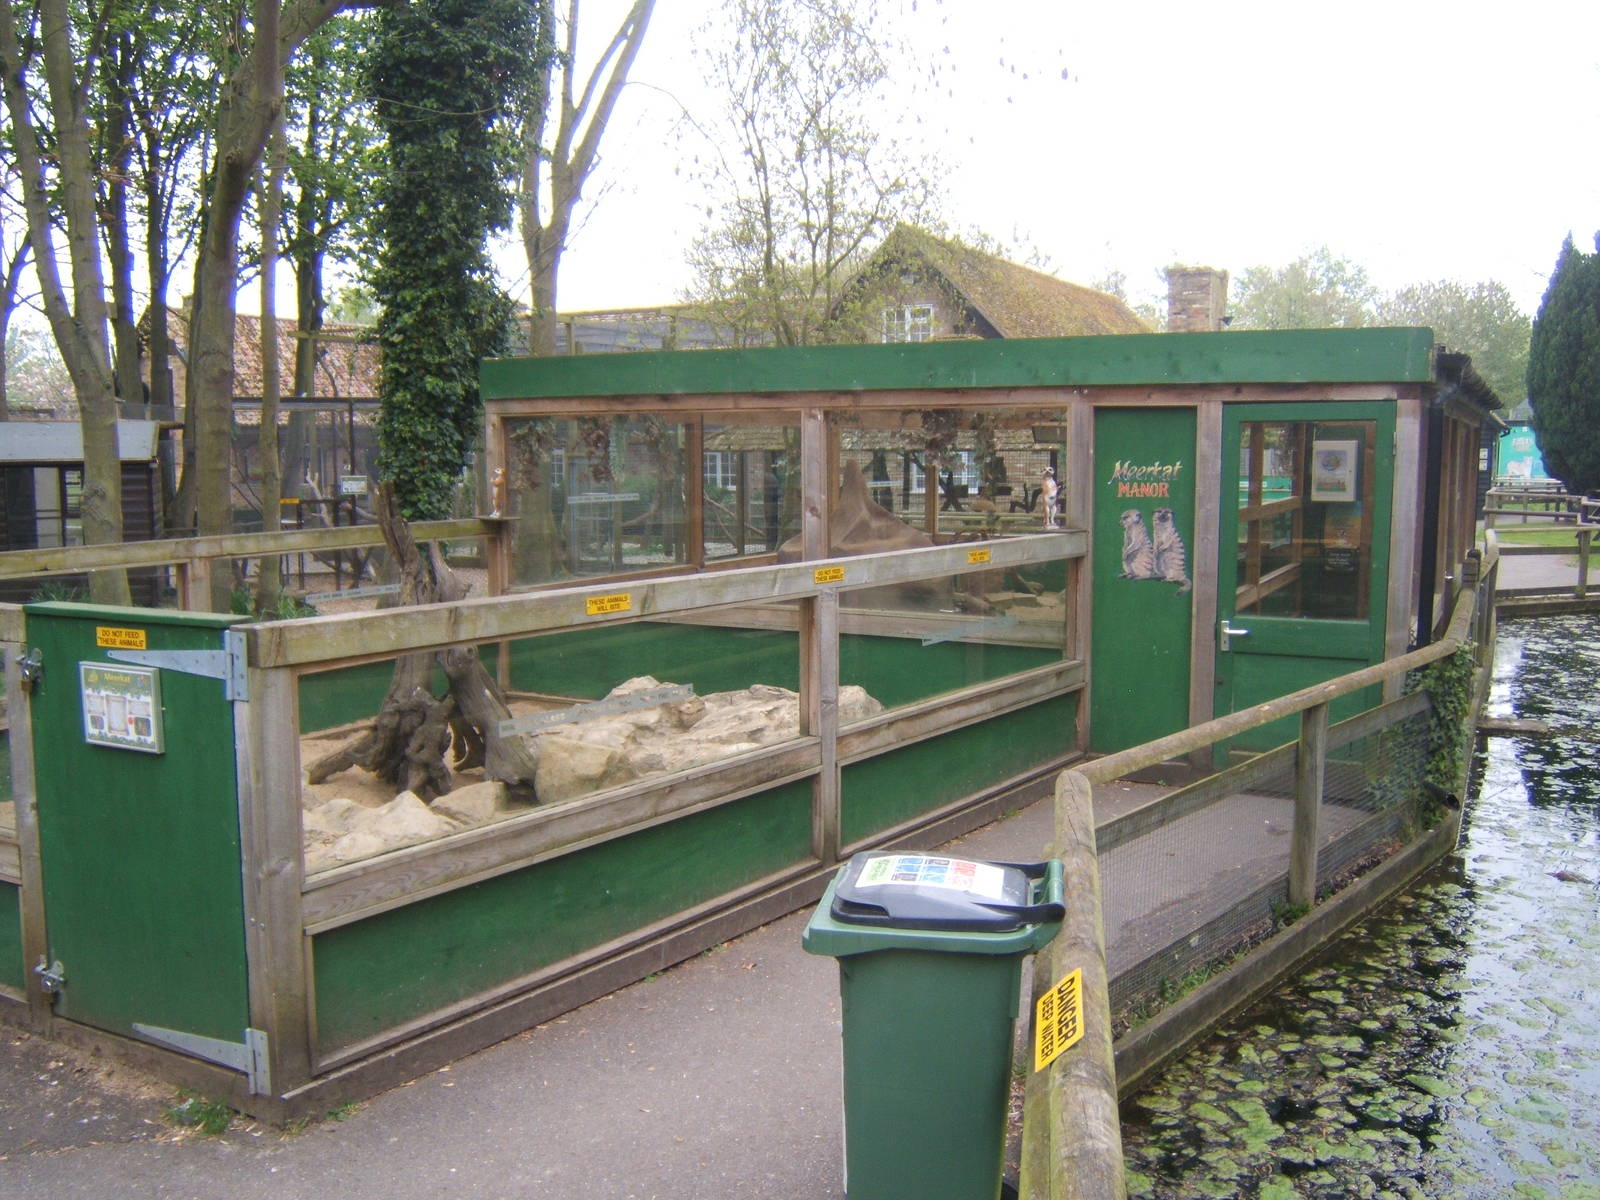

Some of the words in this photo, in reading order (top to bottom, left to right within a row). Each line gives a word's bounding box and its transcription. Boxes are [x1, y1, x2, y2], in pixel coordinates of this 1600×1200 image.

[1107, 460, 1183, 485] Meerkat
[1116, 481, 1169, 498] MANOR
[589, 598, 605, 606] THESE
[606, 595, 628, 603] ANIMALS
[100, 637, 118, 645] THESE
[119, 639, 144, 648] ANIMALS
[101, 629, 111, 637] DO
[112, 630, 123, 638] NOT
[125, 631, 139, 639] FEED
[1042, 993, 1054, 1021] DEEP
[1058, 976, 1077, 1048] DANGER
[1041, 1020, 1054, 1063] WATER
